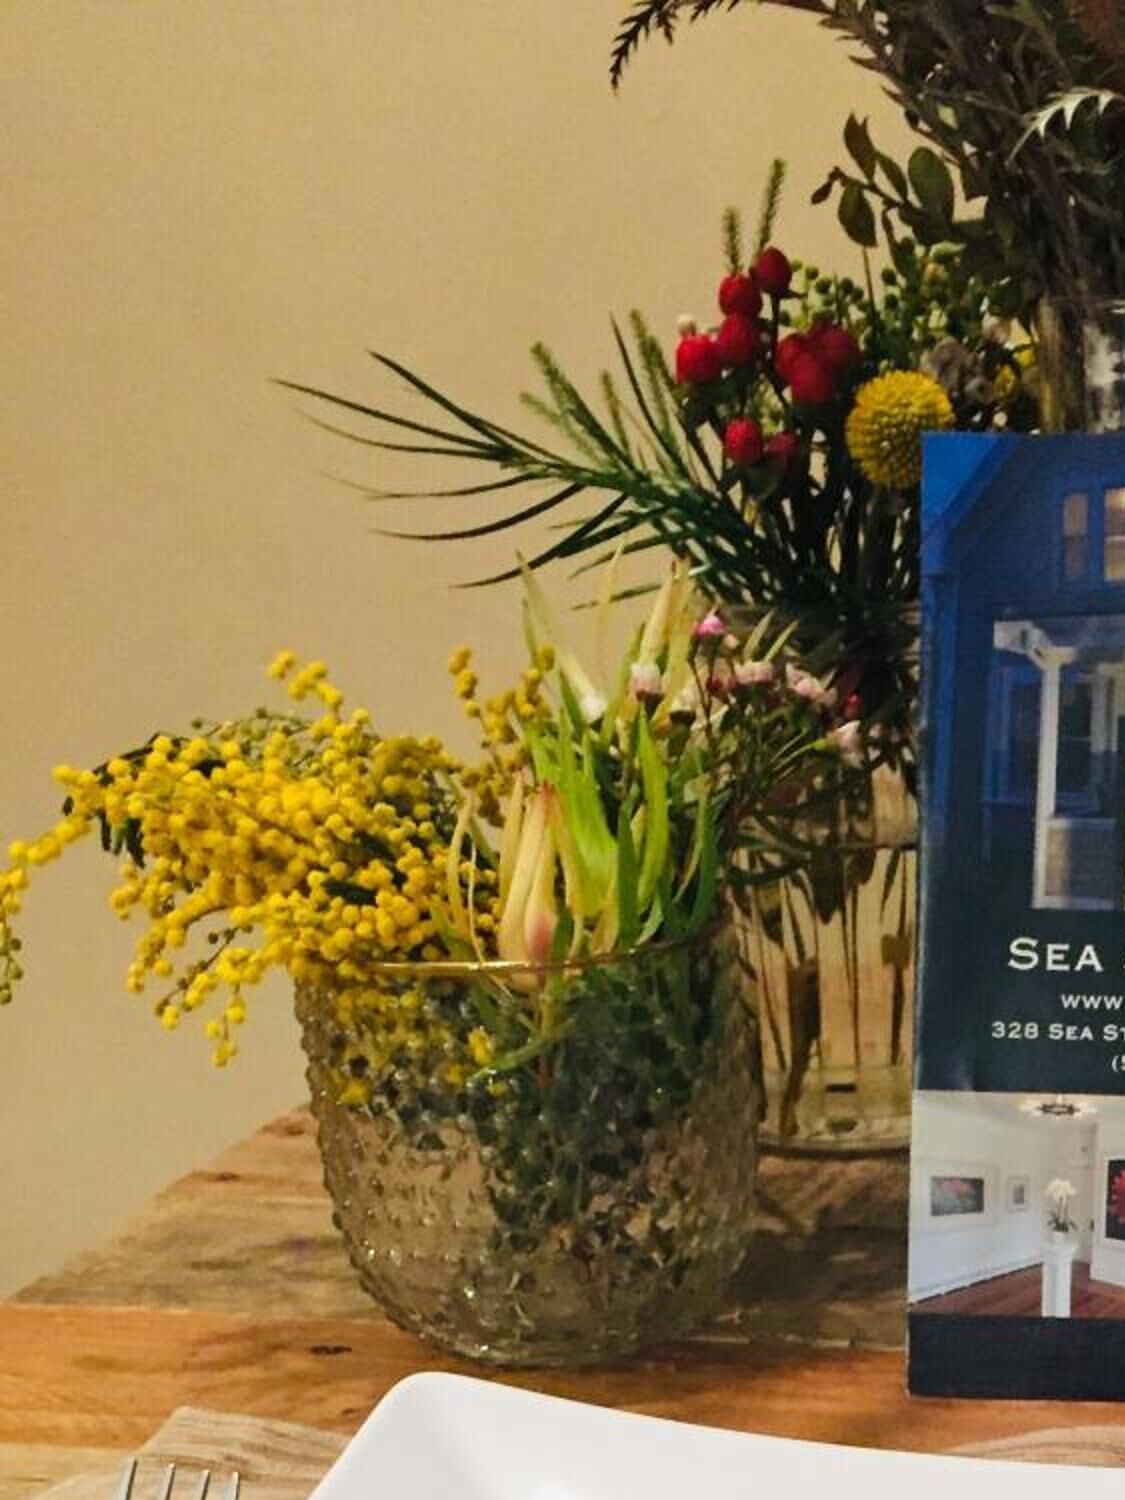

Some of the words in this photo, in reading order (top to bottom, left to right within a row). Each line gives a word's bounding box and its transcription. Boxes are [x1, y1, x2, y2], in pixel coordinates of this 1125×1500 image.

[1007, 936, 1104, 973] SEA
[991, 1020, 1039, 1040] 328
[1048, 1023, 1094, 1041] SEA
